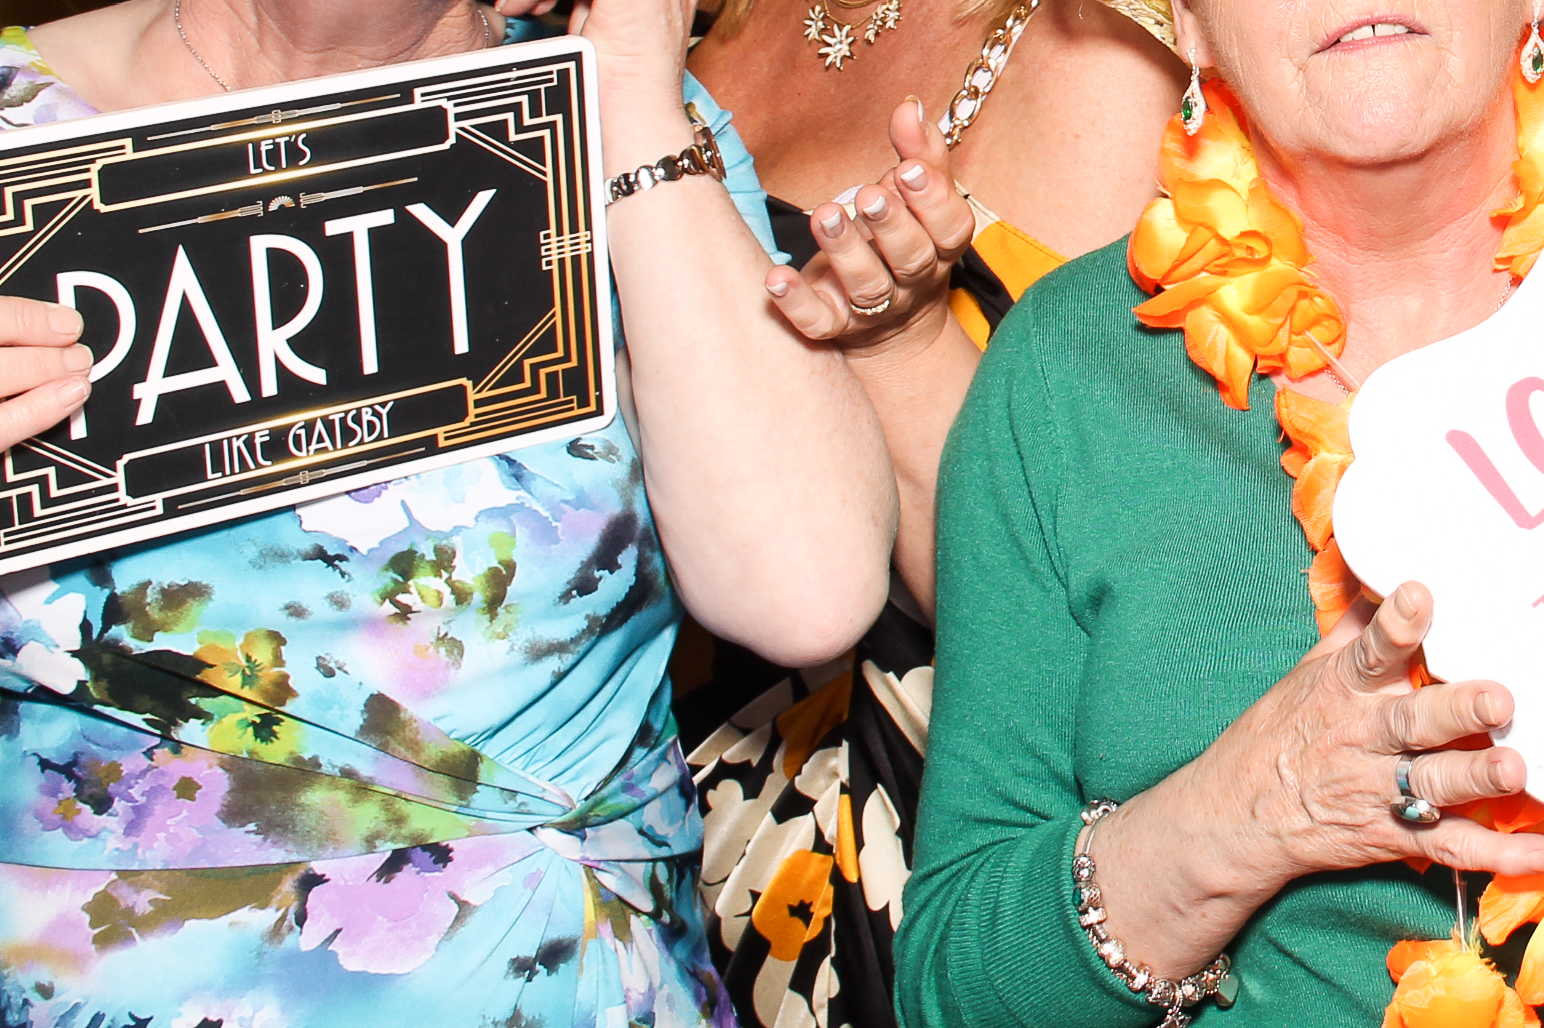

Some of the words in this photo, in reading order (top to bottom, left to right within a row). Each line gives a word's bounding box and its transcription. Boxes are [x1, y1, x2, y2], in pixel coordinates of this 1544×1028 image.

[247, 132, 312, 174] LET'S
[55, 188, 498, 441] PARTY
[204, 429, 273, 480] LIKE
[287, 401, 397, 458] GATSBY
